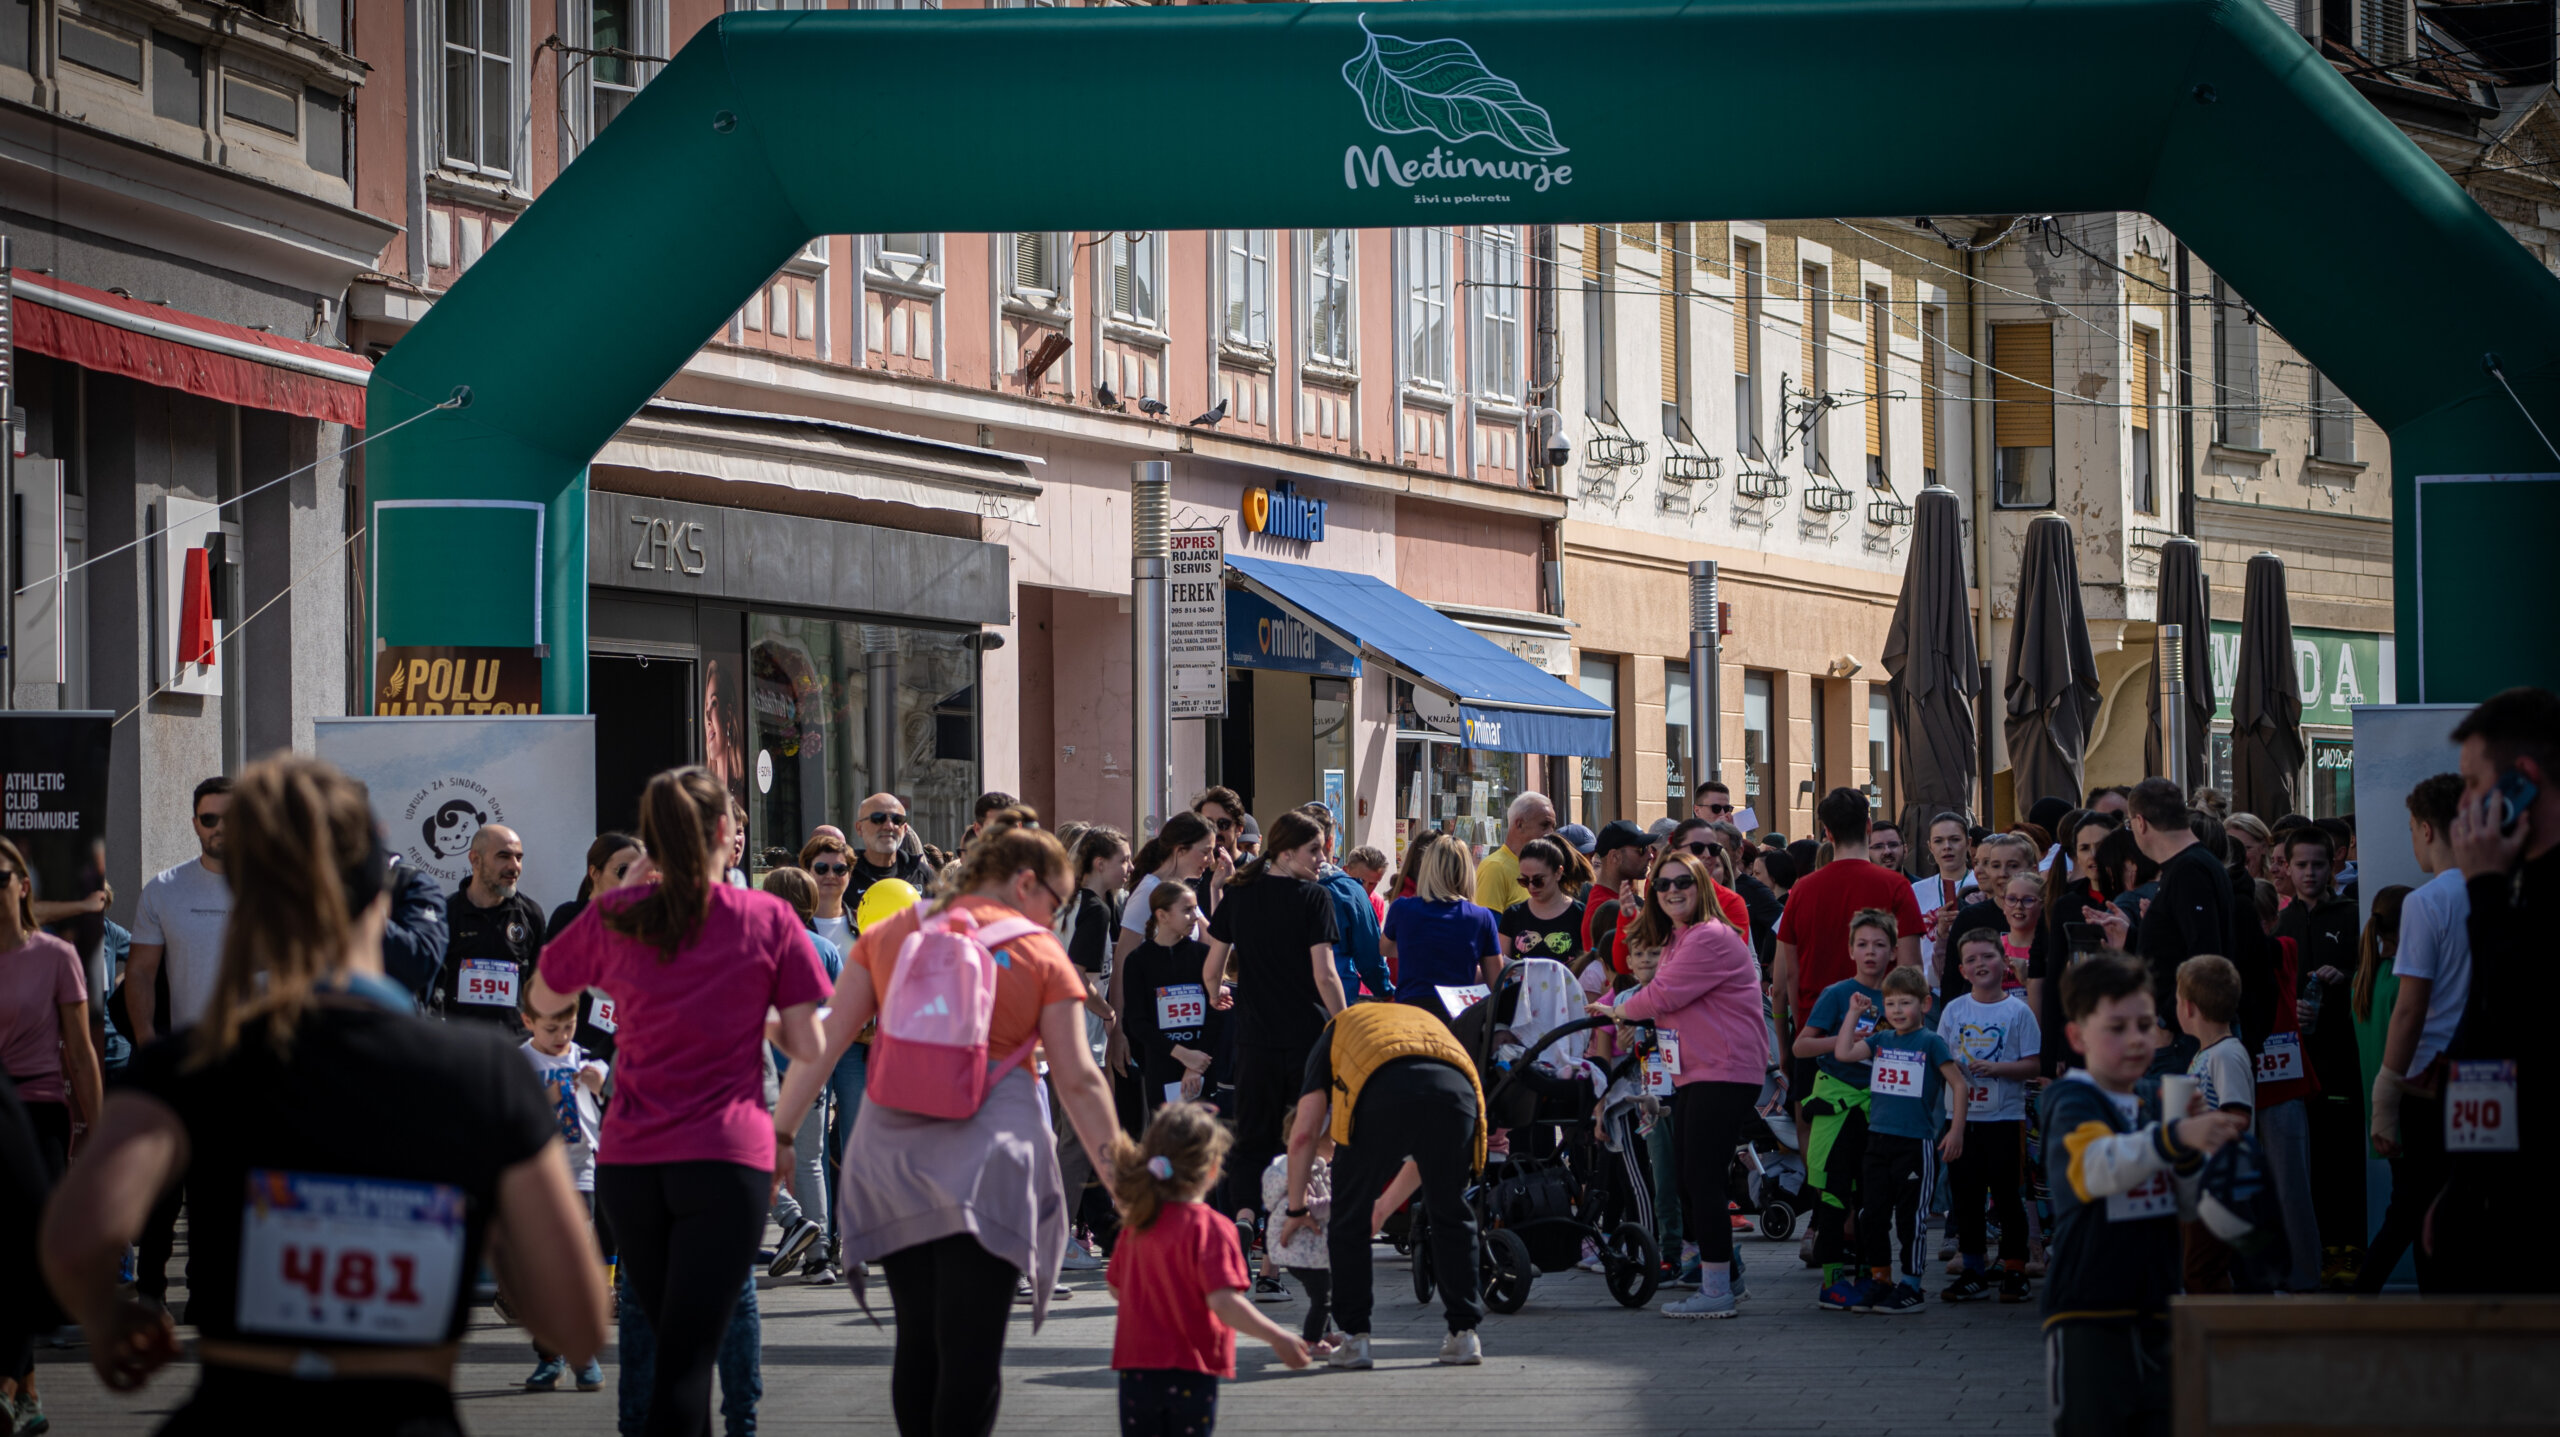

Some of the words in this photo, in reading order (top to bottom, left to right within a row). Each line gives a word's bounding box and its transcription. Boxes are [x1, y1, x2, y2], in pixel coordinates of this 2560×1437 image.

[1344, 145, 1572, 192] Međimurje
[1414, 194, 1439, 204] živi
[1454, 193, 1510, 204] pokretu
[975, 491, 1009, 518] ZAKS
[1268, 480, 1328, 542] mlinar
[631, 515, 706, 574] ZAKS
[1171, 536, 1215, 549] EXPRES
[1171, 549, 1219, 561] ROJAČKI
[1173, 563, 1212, 574] SERVIS
[406, 658, 500, 701] POLU
[2211, 632, 2364, 706] MDA
[1474, 714, 1501, 745] mlinar
[5, 773, 65, 791] ATHLETIC
[5, 792, 38, 810] CLUB
[405, 789, 429, 820] UDRUGA
[431, 780, 444, 791] ZA
[449, 777, 488, 797] SINDROM
[488, 797, 505, 823] DOWN
[5, 811, 79, 829] MEĐIMURJE
[469, 978, 510, 995] 594
[1167, 1002, 1202, 1018] 529
[1877, 1067, 1911, 1085] 231
[2453, 1099, 2502, 1130] 240
[280, 1246, 422, 1307] 481
